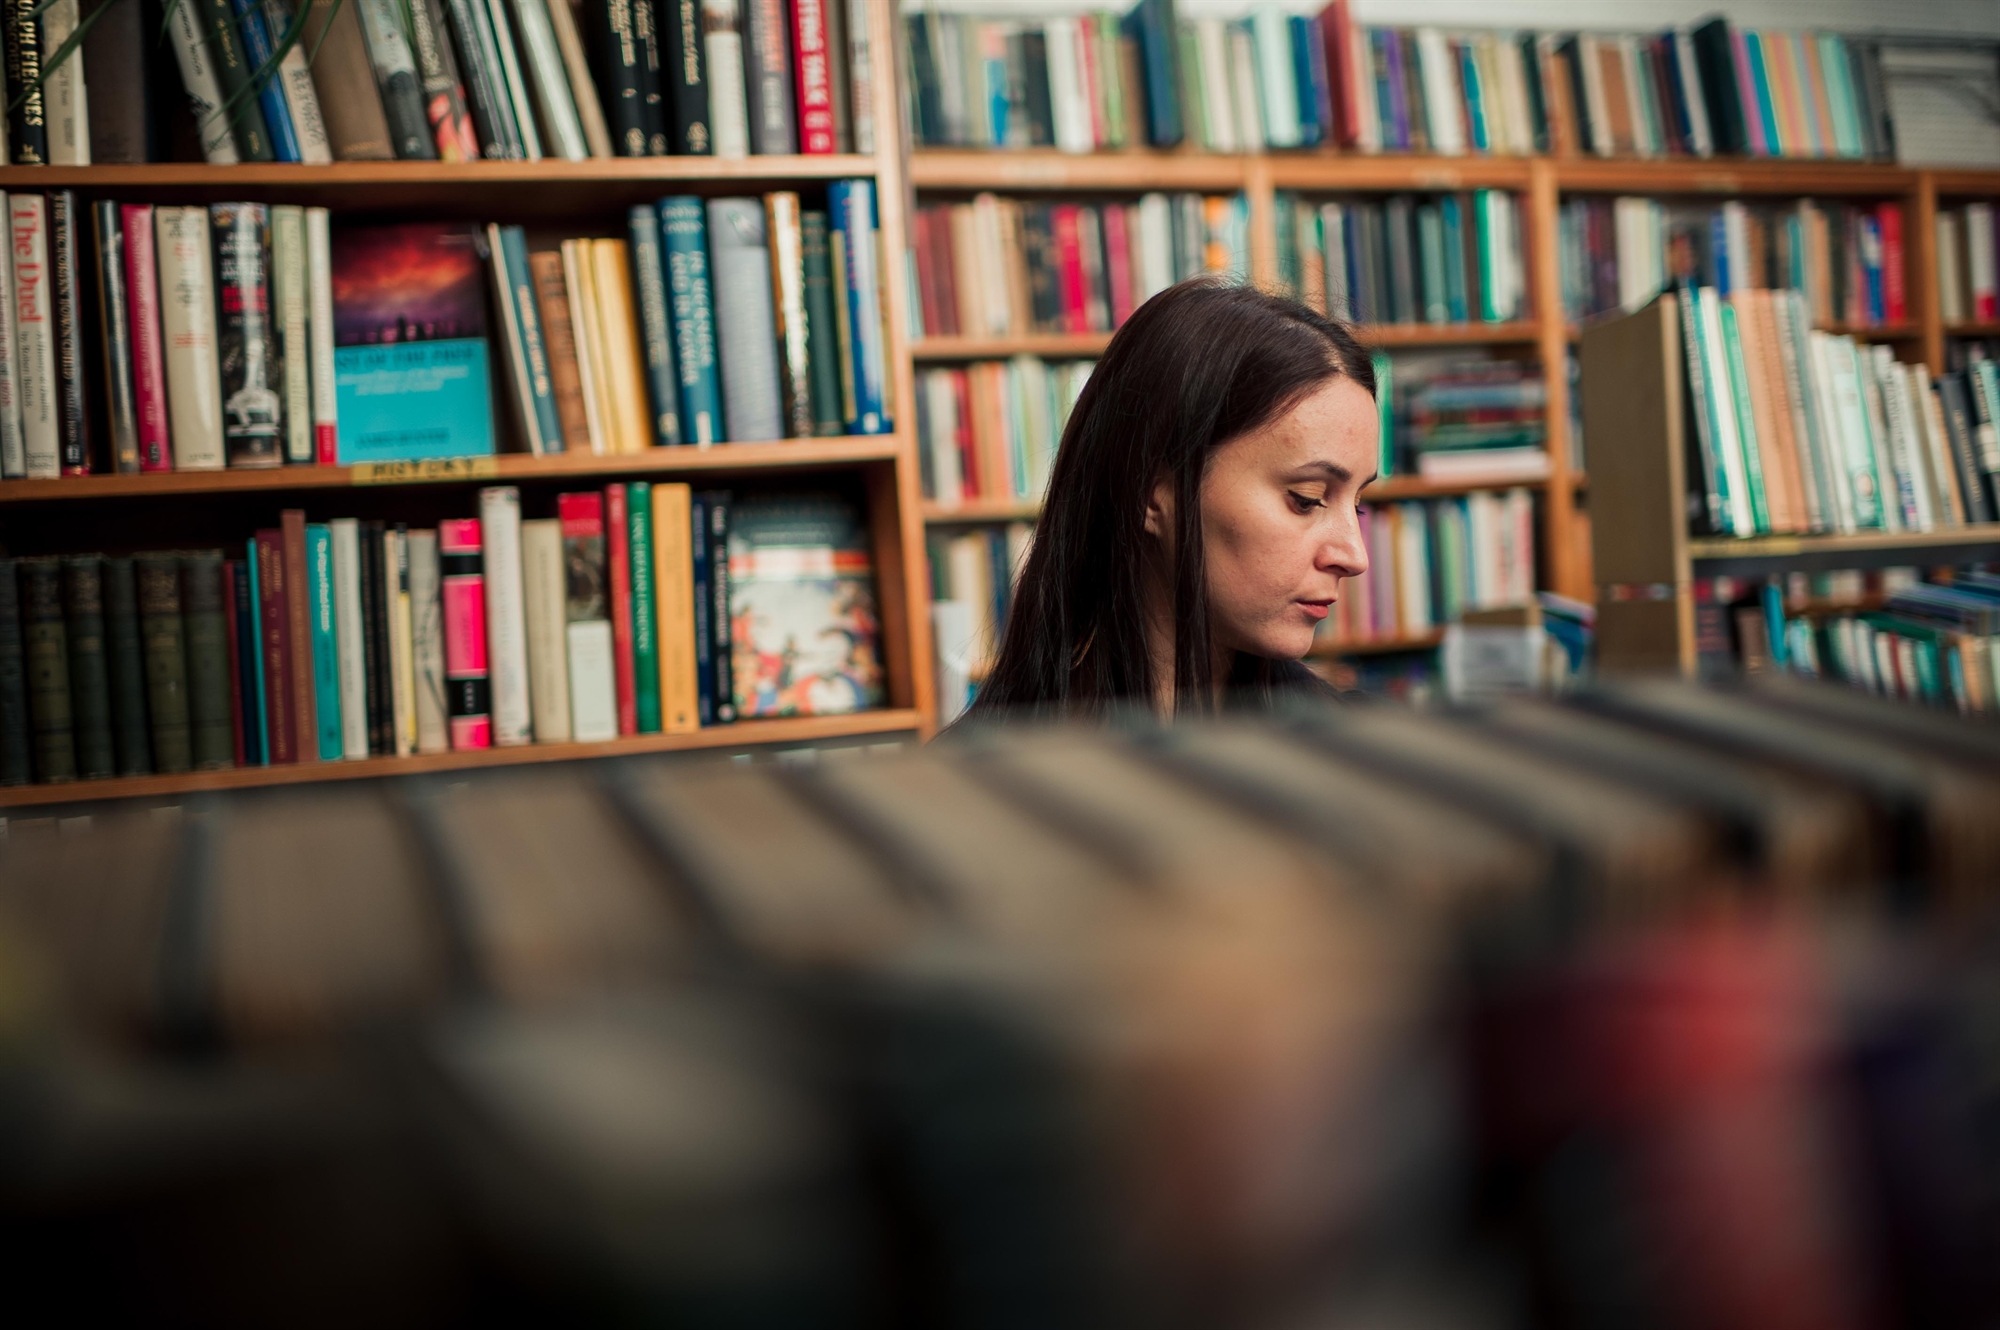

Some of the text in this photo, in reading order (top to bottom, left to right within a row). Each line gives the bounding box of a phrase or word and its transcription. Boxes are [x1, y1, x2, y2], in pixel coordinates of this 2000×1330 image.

[12, 203, 43, 323] The Duel
[53, 193, 75, 380] THE VICTORIAN TOWN CHILD
[669, 250, 699, 387] AND IN POWER
[373, 459, 476, 476] HISTORY
